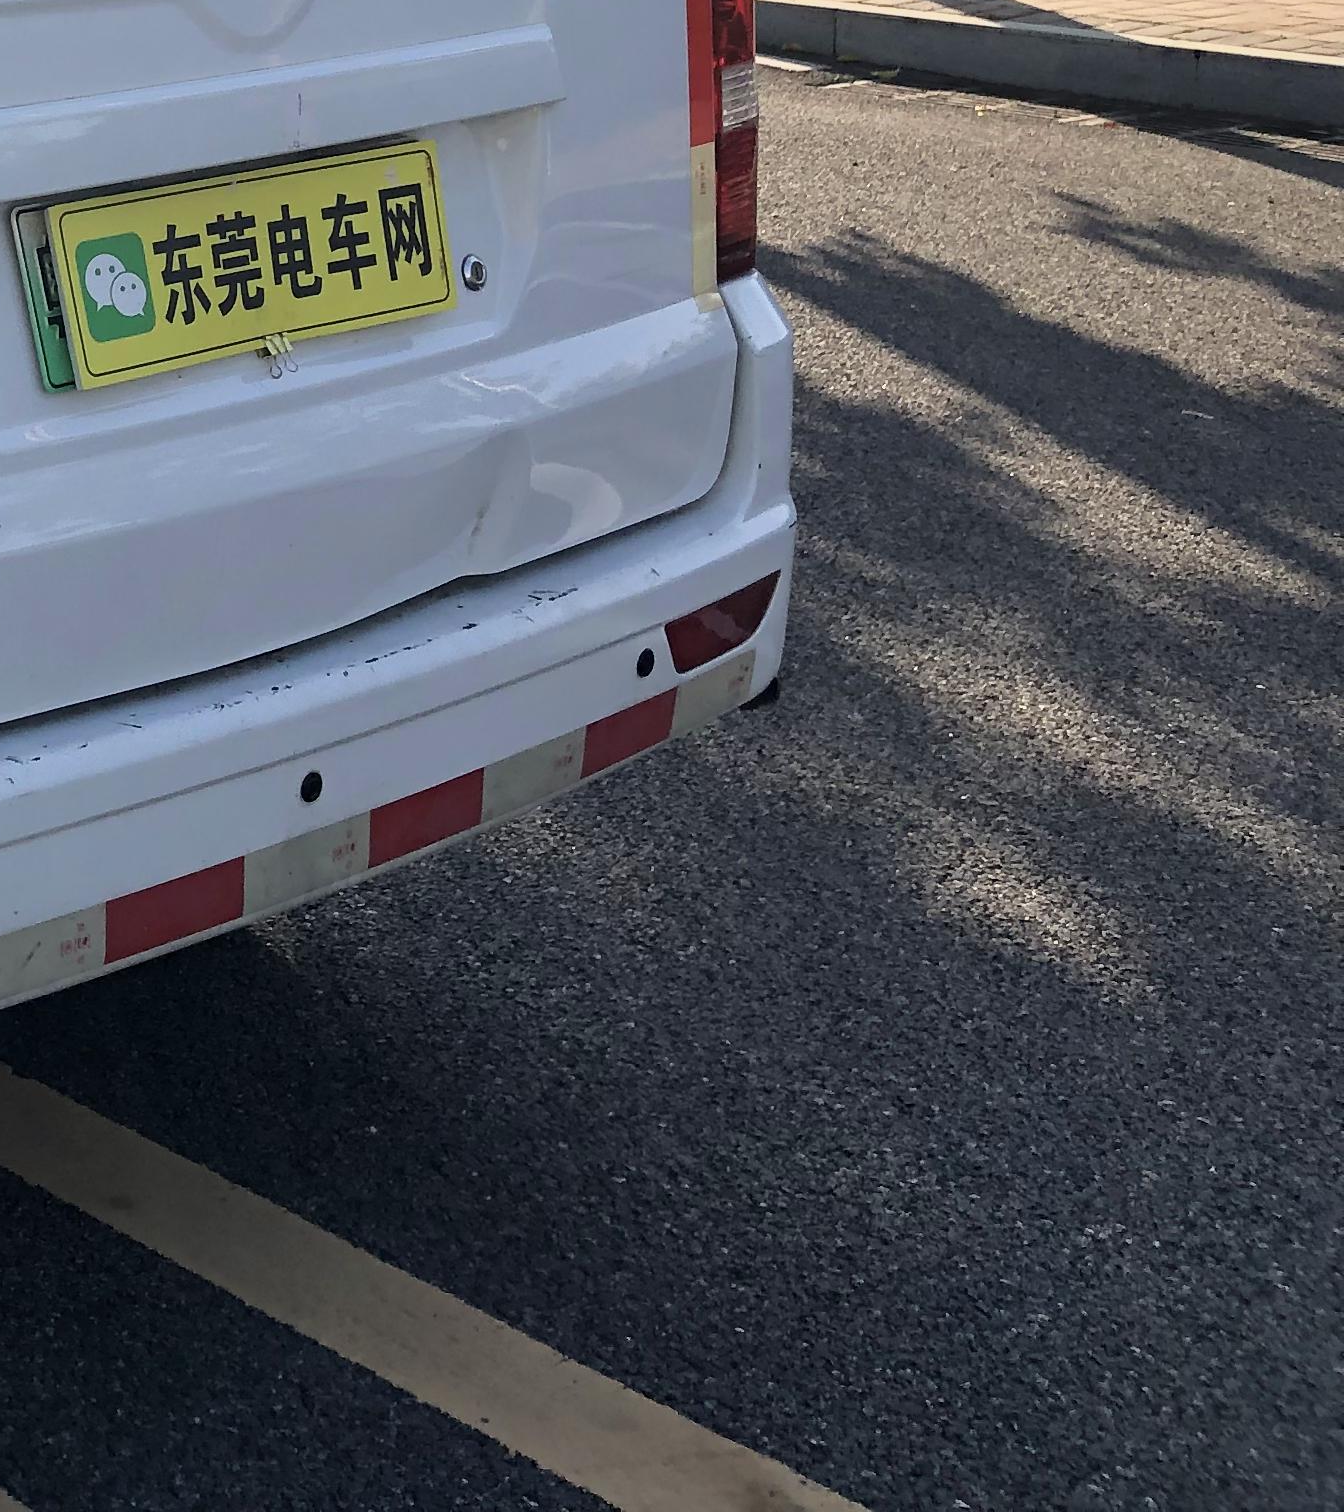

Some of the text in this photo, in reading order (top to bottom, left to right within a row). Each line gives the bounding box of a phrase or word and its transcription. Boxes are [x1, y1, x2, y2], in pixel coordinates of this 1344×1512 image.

[153, 183, 433, 325] 东莞电车网
